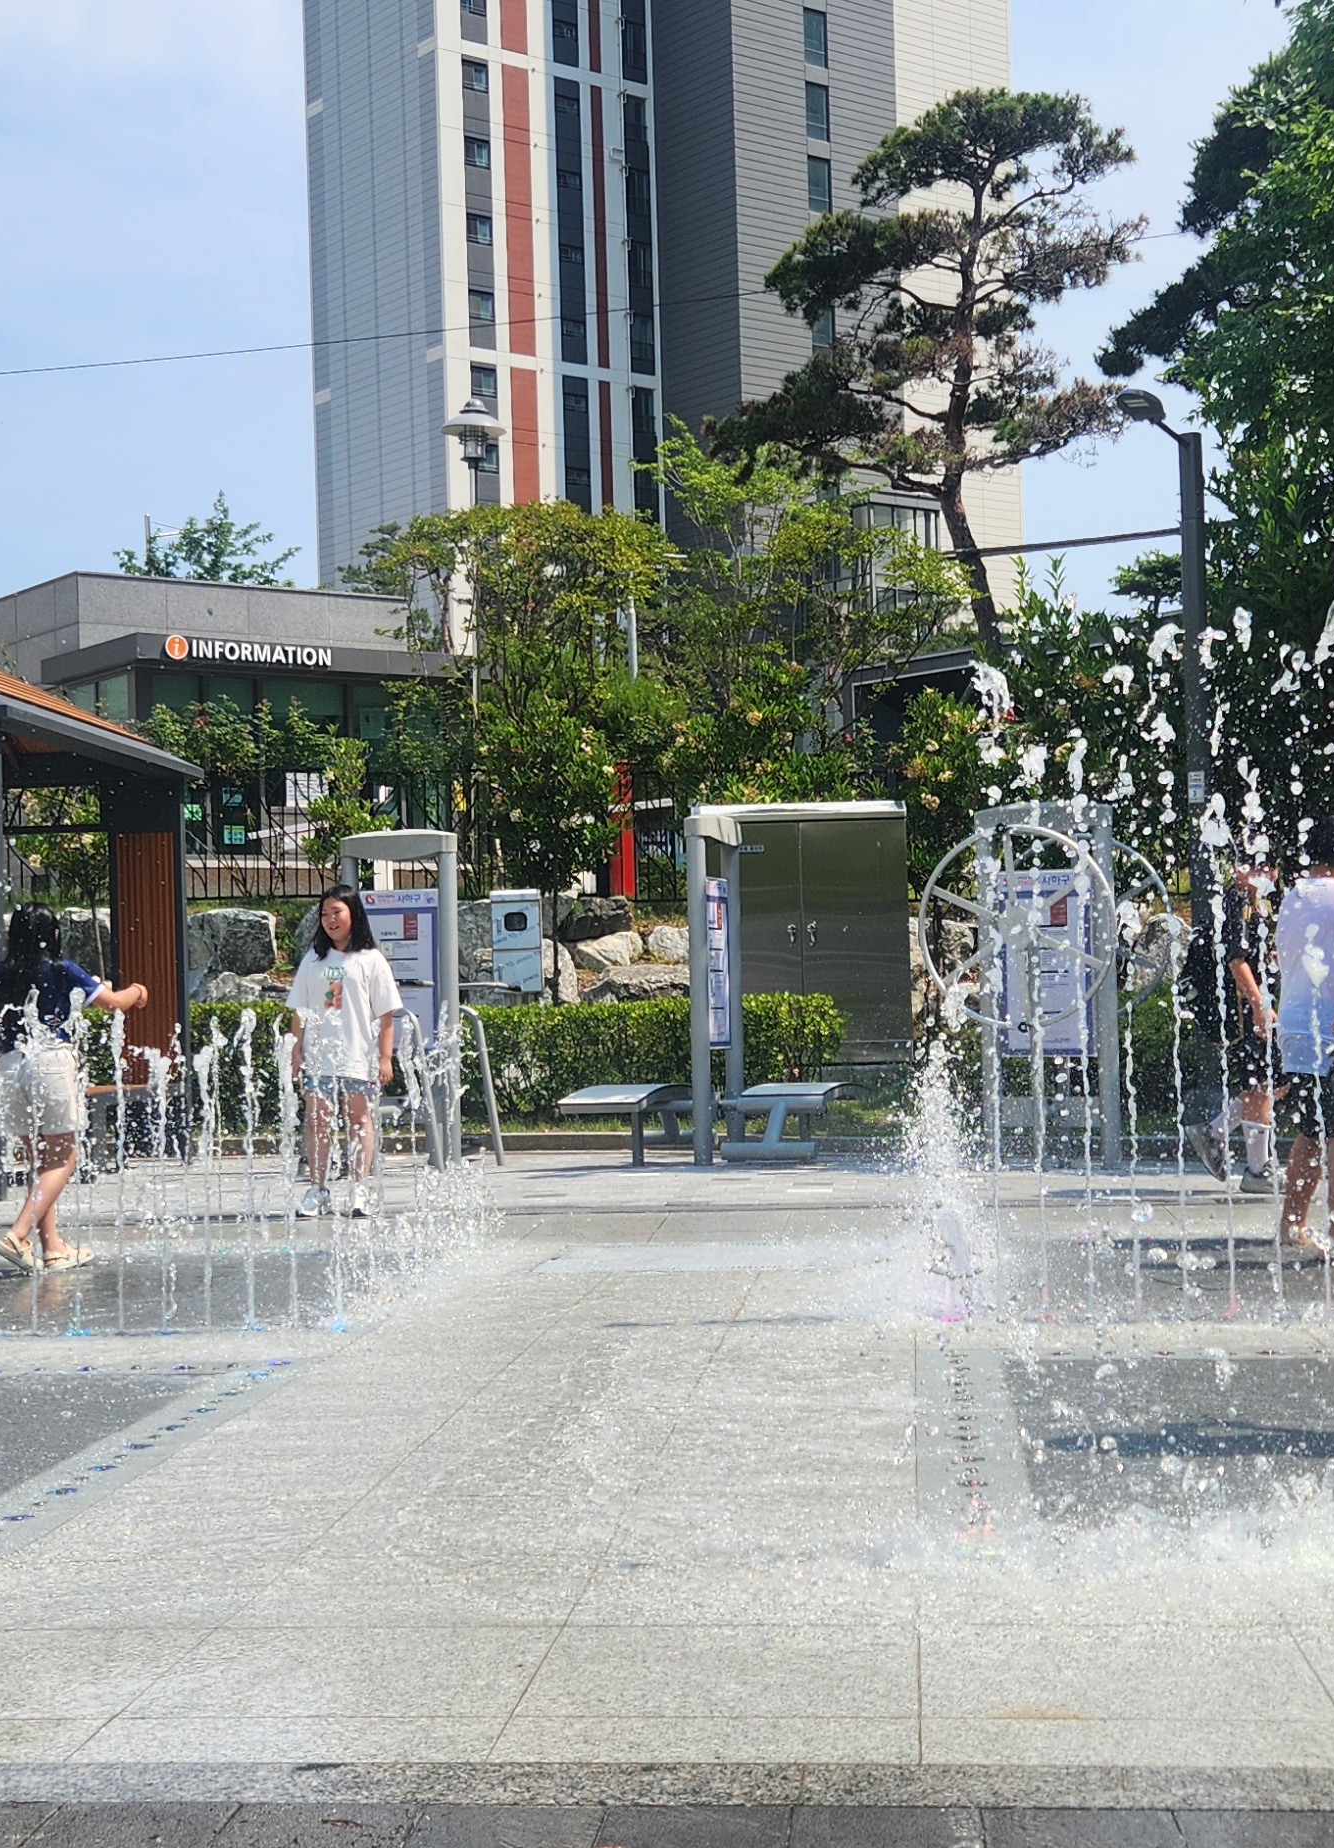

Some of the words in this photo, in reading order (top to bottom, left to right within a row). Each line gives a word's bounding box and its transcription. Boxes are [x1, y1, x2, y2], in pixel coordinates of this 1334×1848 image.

[192, 639, 332, 667] INFORMATION
[1042, 875, 1070, 885] 사하구
[397, 894, 421, 904] 사하구
